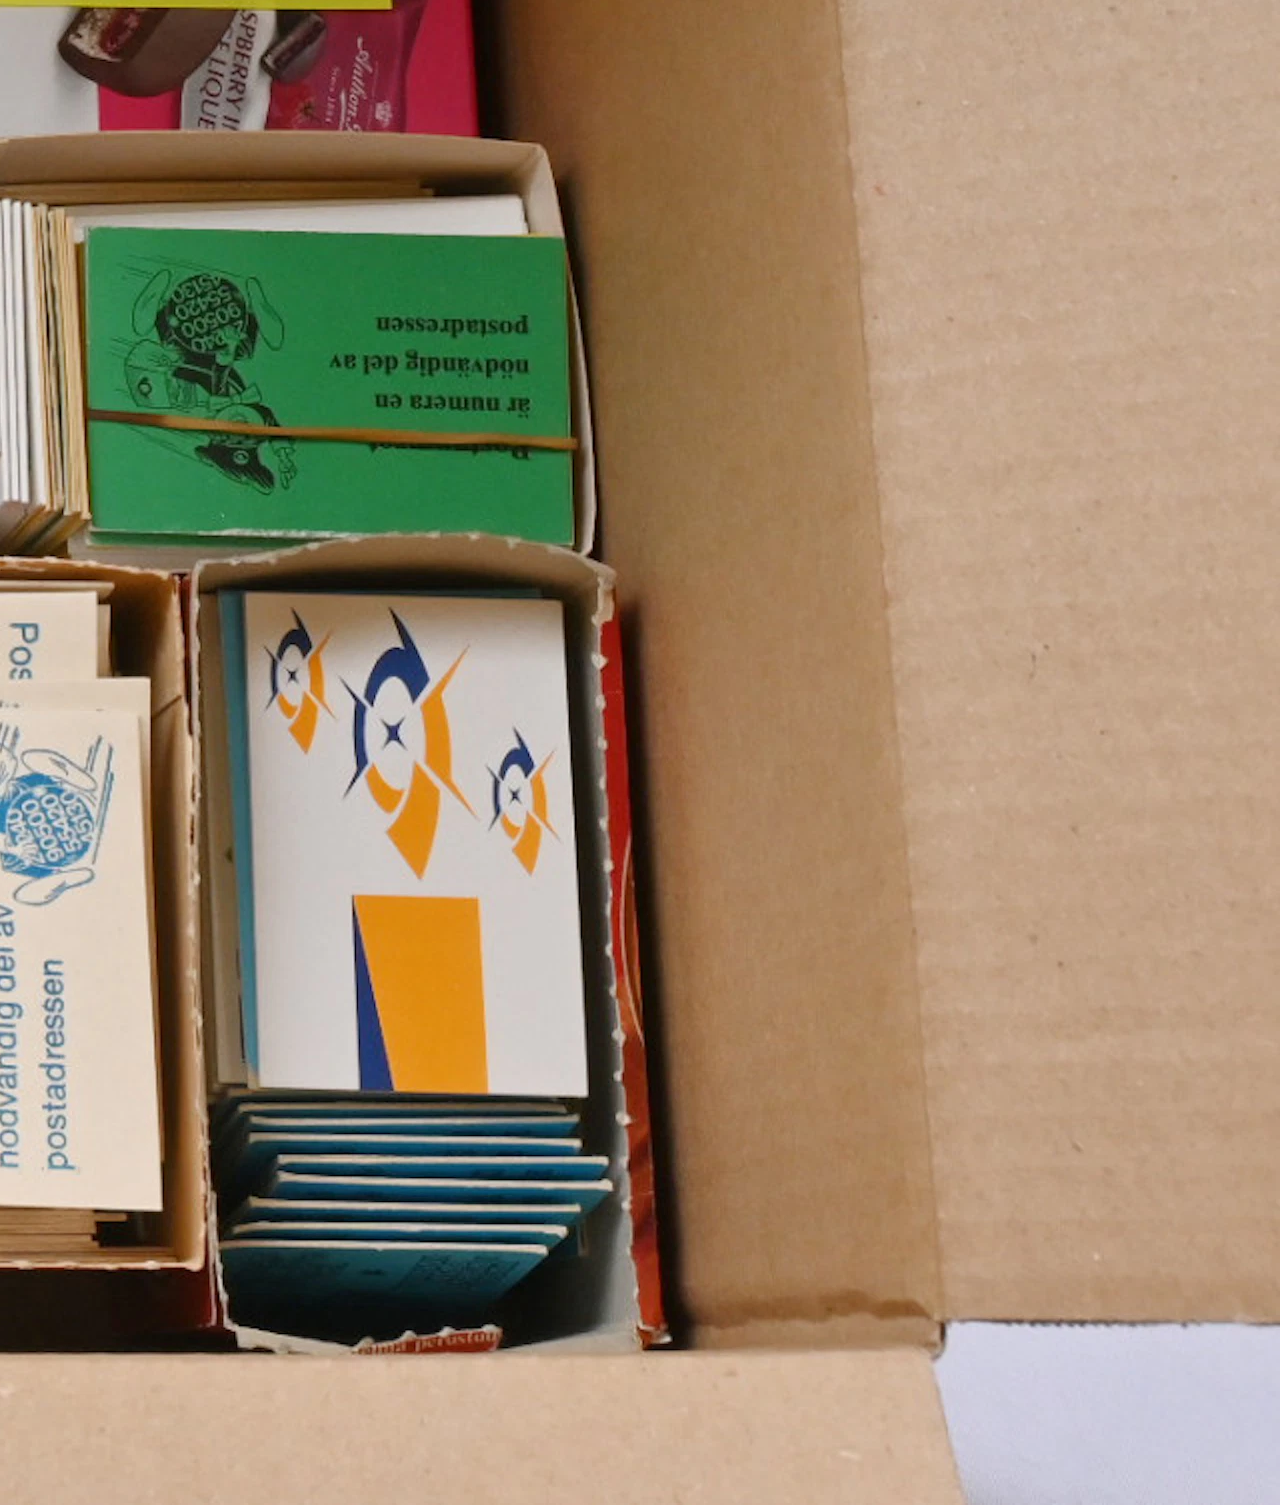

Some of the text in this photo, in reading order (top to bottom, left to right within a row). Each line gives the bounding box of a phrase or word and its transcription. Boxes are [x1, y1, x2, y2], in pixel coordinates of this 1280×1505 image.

[174, 285, 233, 320] 55420
[181, 303, 240, 339] 90500
[375, 314, 529, 338] postadressen
[329, 349, 529, 379] nödvändig del av
[375, 393, 530, 418] är numera en
[22, 799, 65, 862] 90500
[39, 959, 77, 1170] postadressen
